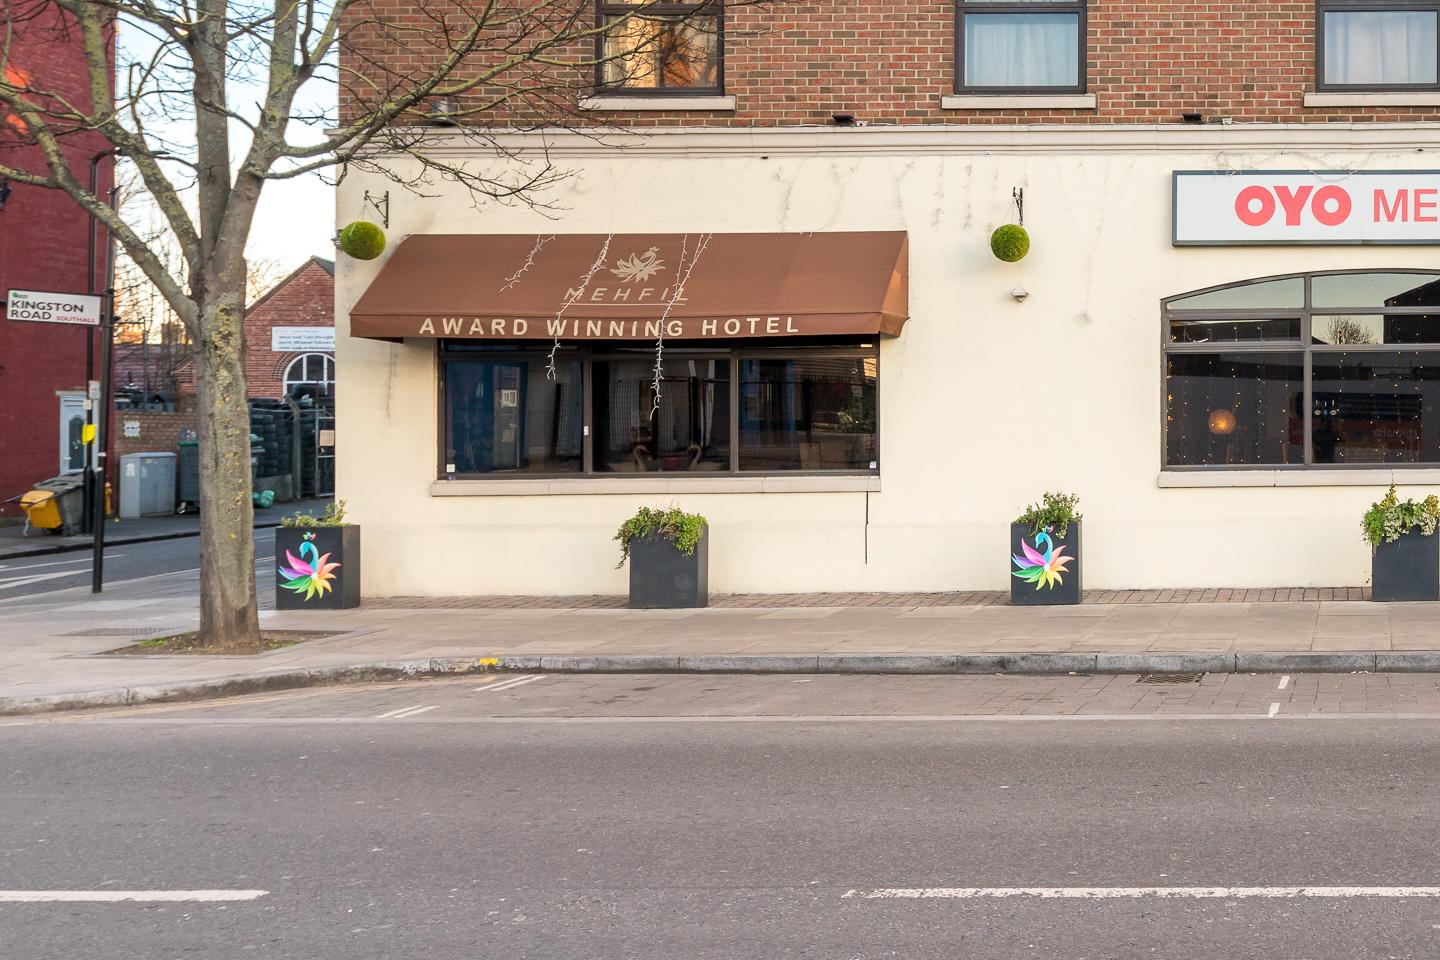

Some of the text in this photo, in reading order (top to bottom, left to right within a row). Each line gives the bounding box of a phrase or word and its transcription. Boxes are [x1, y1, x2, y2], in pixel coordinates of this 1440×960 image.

[1234, 185, 1352, 226] OYO
[564, 287, 689, 302] MEHFIL
[11, 300, 84, 313] KINGSTON
[10, 309, 96, 323] ROAD SOUTHALL
[418, 316, 799, 337] AWARD WINNING HOTEL
